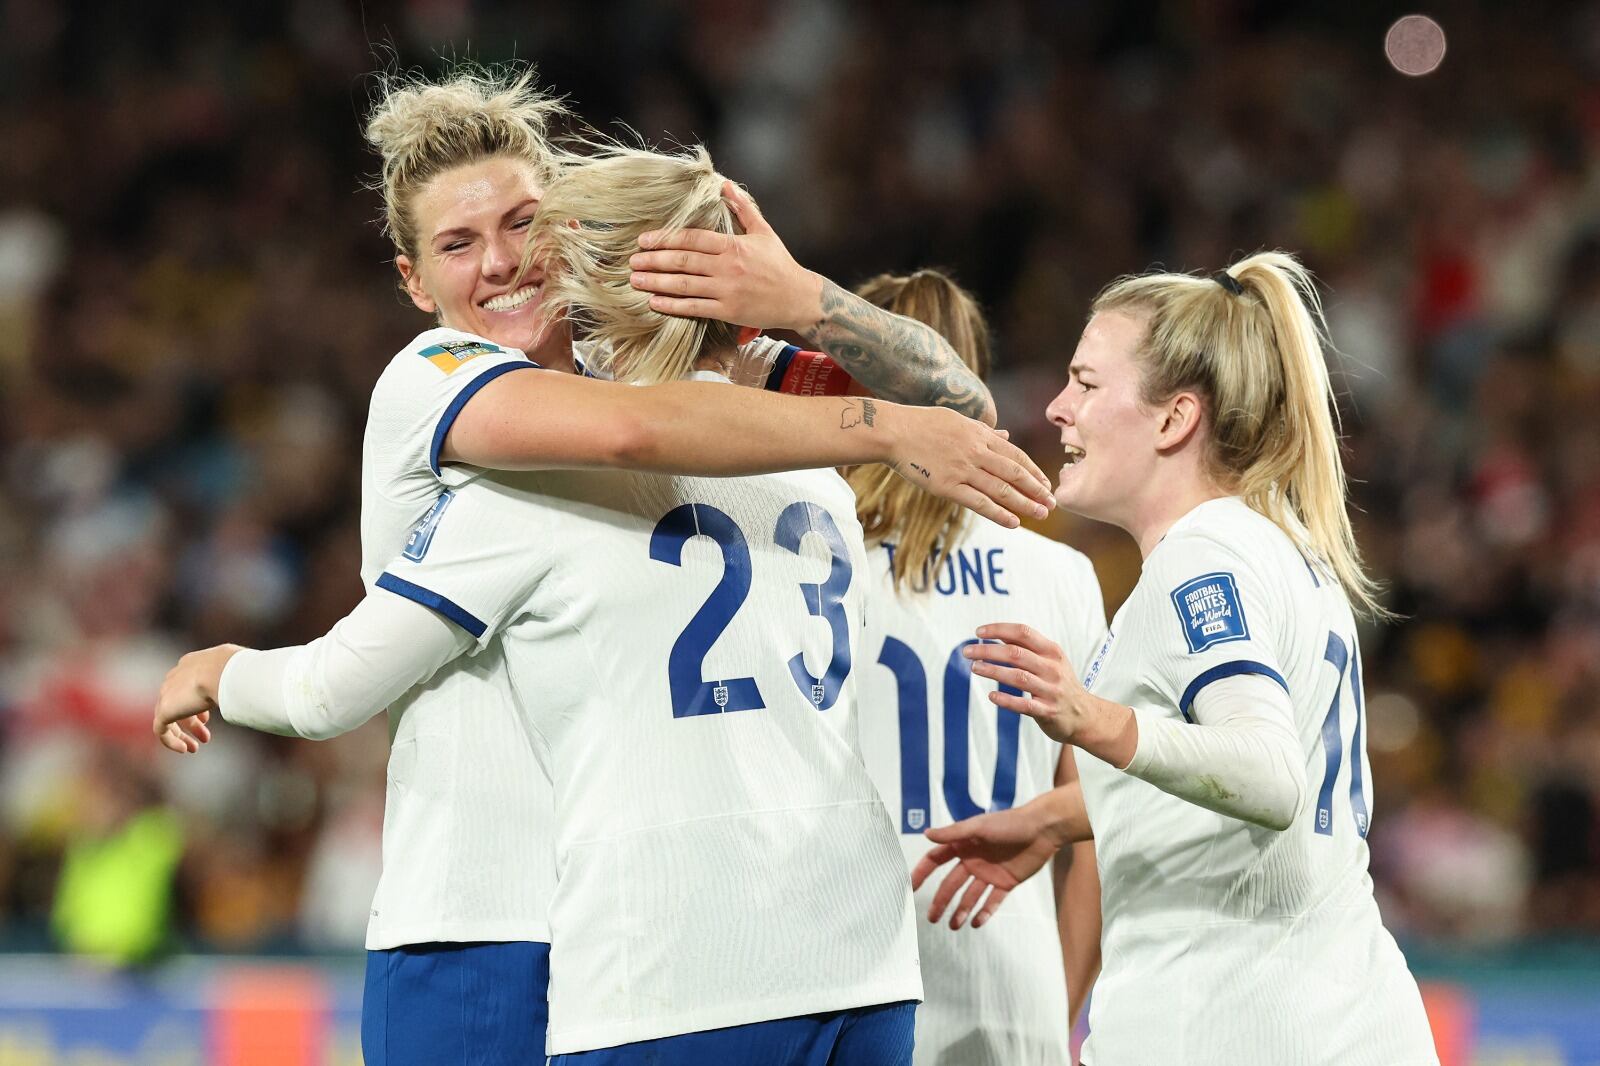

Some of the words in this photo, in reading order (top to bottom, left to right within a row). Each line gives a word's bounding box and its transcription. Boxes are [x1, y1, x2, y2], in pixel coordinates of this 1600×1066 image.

[1184, 583, 1224, 606] FOOTBALL
[1187, 592, 1227, 618] UNITES
[649, 501, 853, 718] 23
[1190, 615, 1205, 630] the
[1204, 604, 1232, 621] World
[1205, 623, 1222, 633] FIFA
[877, 635, 1023, 834] 10
